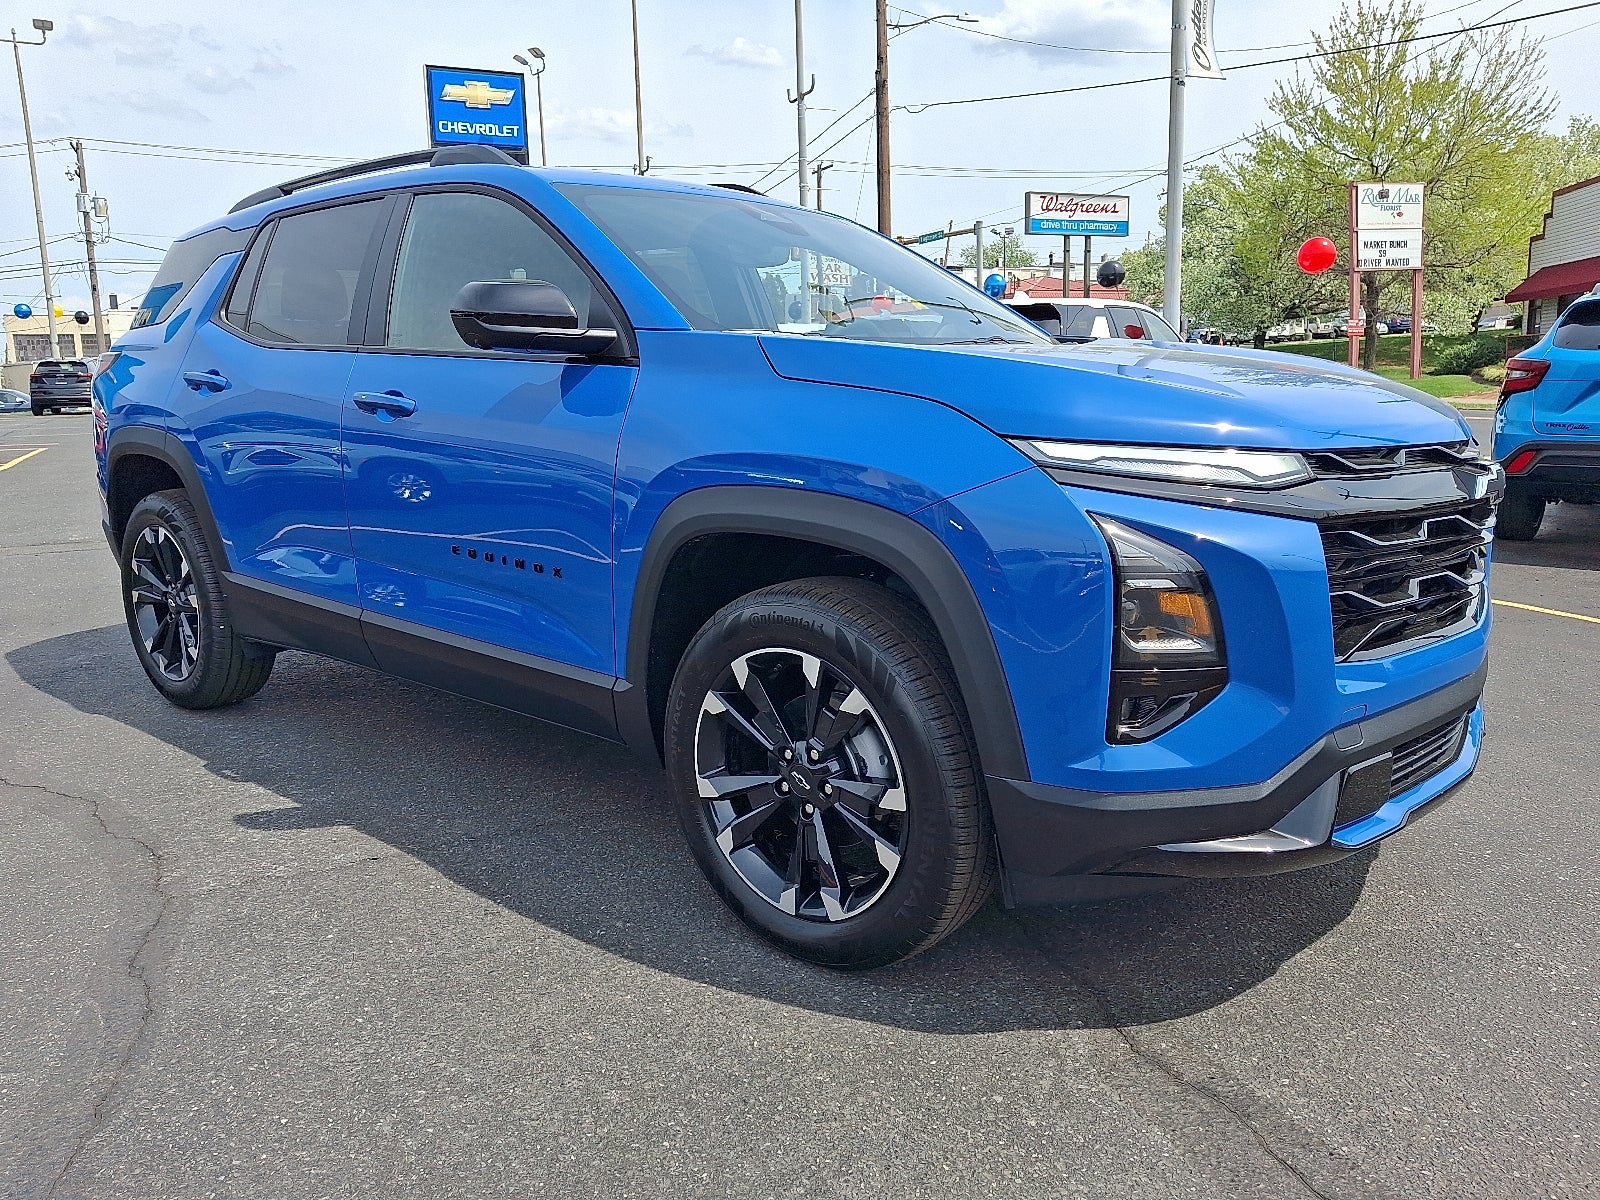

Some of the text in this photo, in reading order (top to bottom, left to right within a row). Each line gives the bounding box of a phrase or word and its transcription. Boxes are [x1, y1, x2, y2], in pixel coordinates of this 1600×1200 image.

[438, 120, 519, 137] CHEVROLET
[1040, 194, 1119, 218] Walgreens
[1380, 204, 1402, 212] FLORIST
[1041, 220, 1118, 232] drive thru pharmacy
[1363, 240, 1408, 249] MARKET BUNCH
[1385, 257, 1410, 267] WANTED
[451, 544, 562, 578] EQUINOX
[749, 611, 816, 631] Continental
